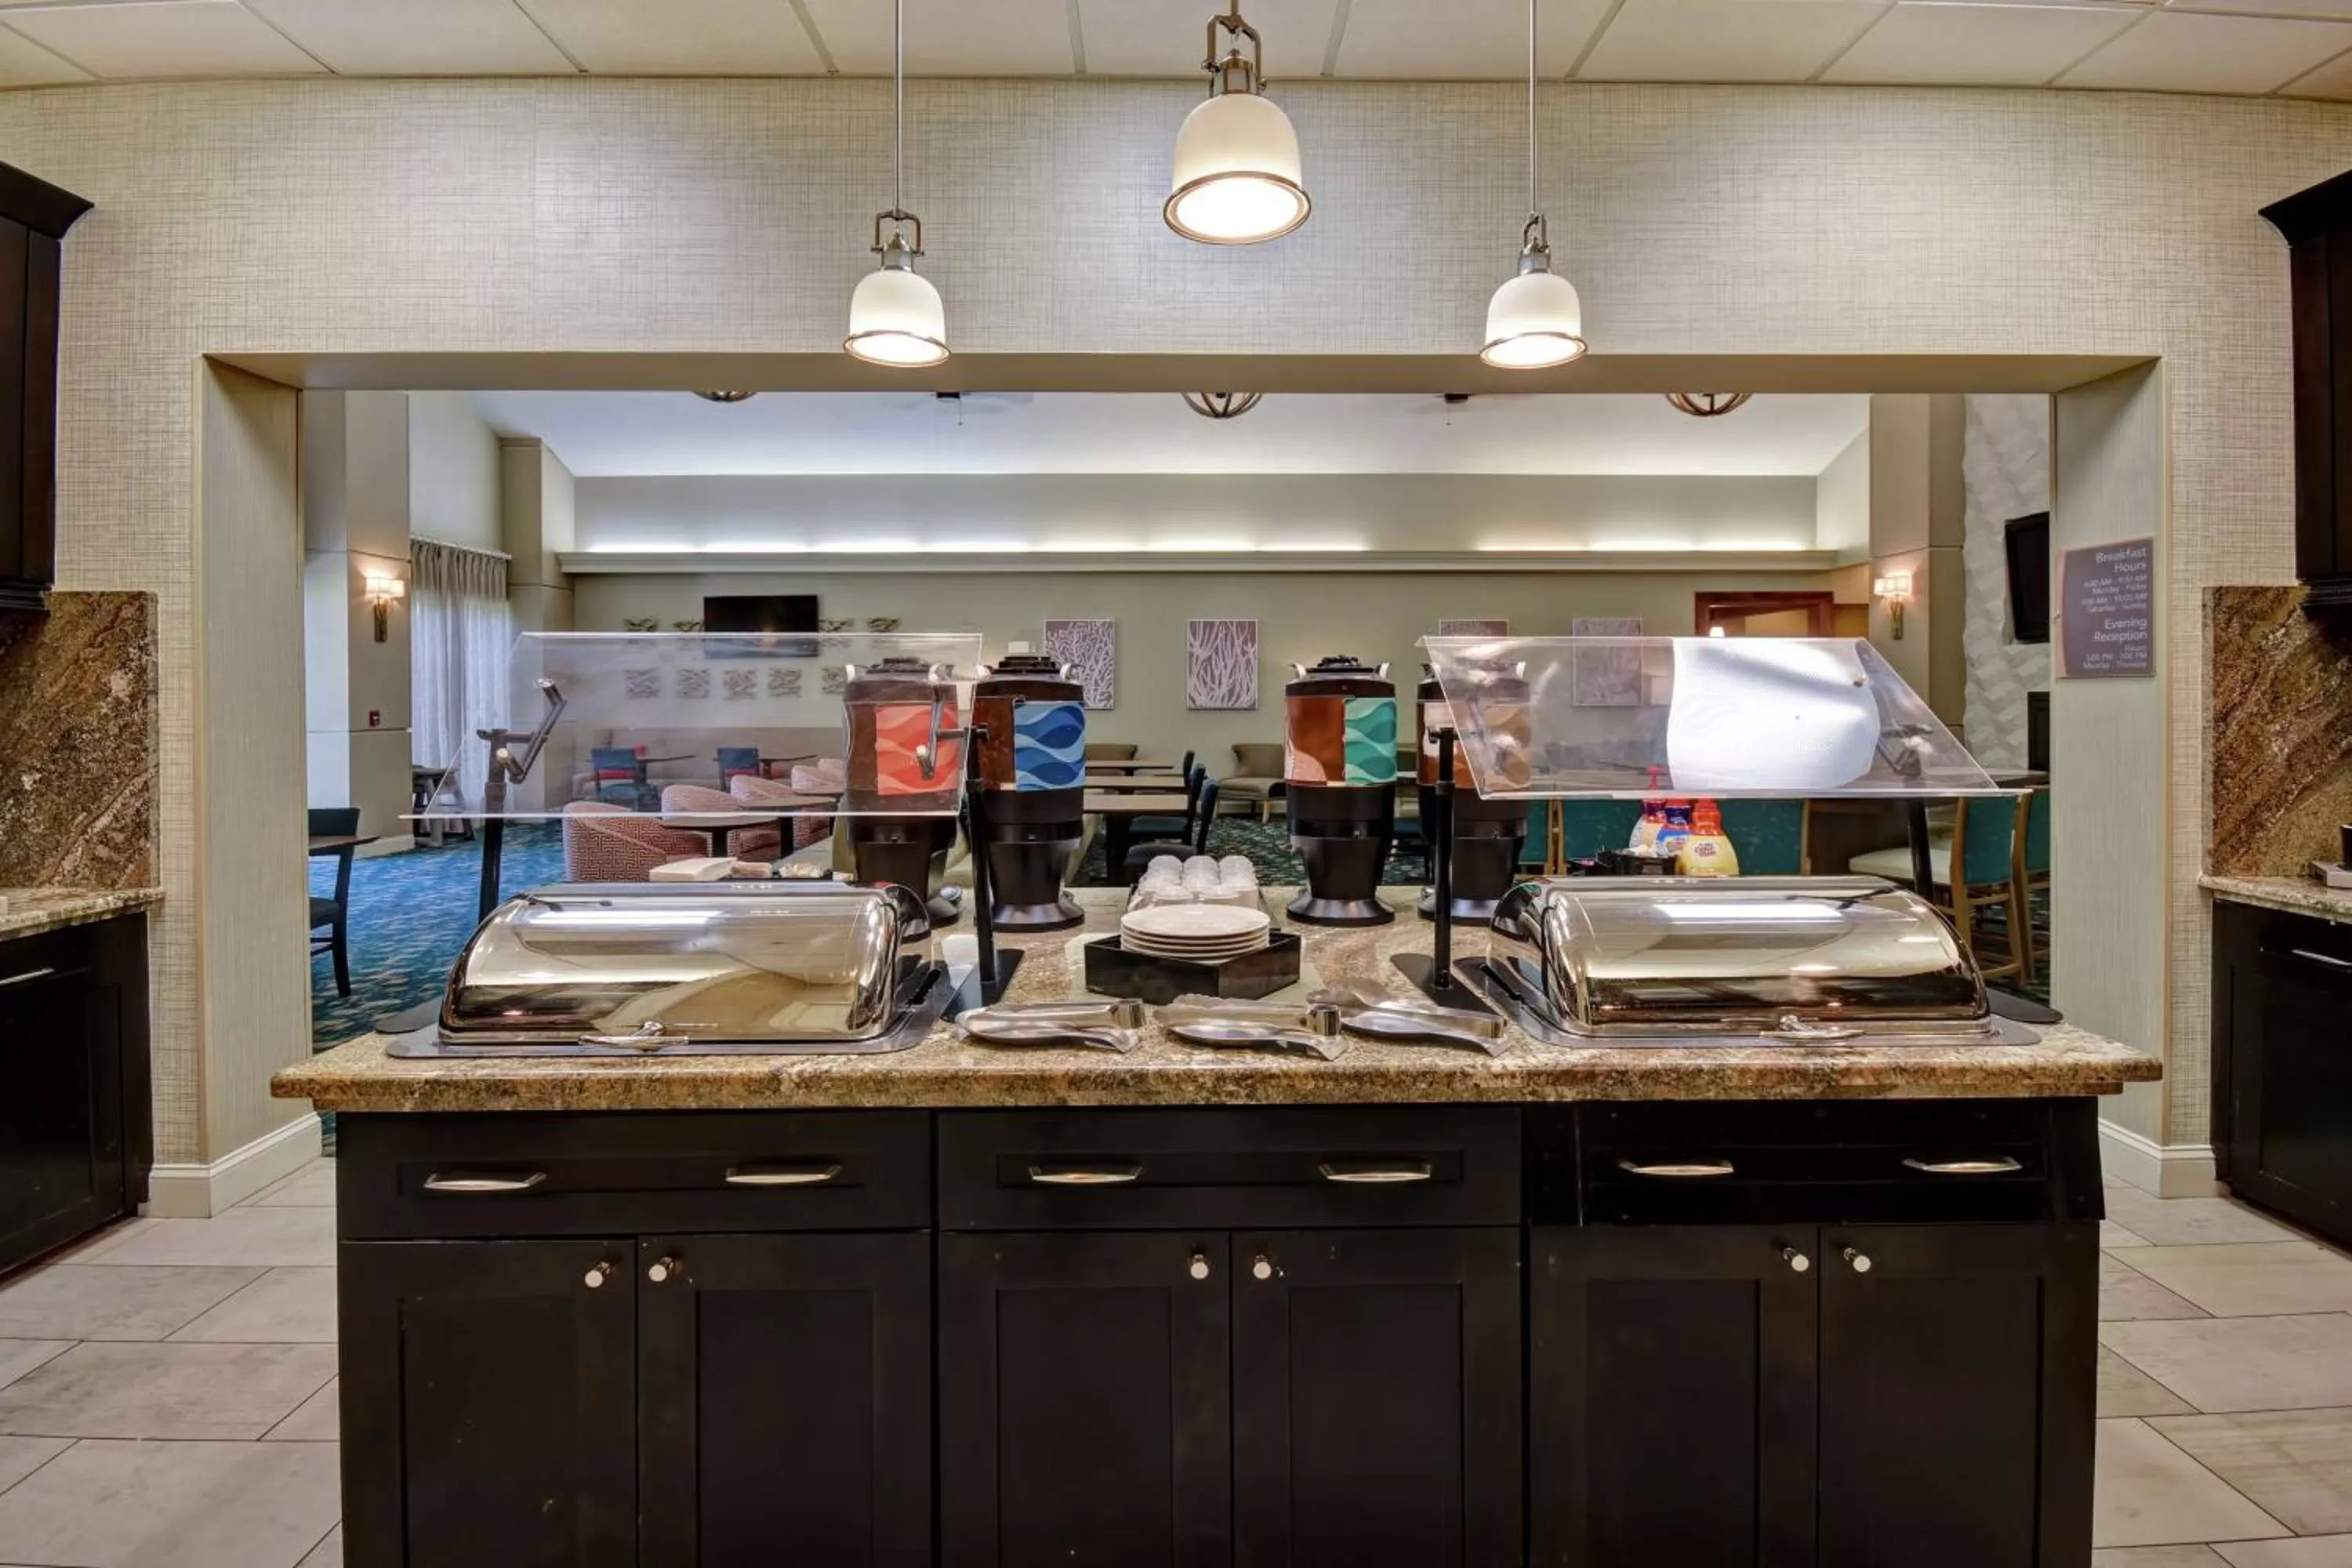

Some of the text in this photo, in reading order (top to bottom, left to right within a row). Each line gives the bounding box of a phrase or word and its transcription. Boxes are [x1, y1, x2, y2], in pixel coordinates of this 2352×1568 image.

[2114, 563, 2147, 572] Hours
[2104, 618, 2147, 630] Evening
[2094, 631, 2147, 644] Reception
